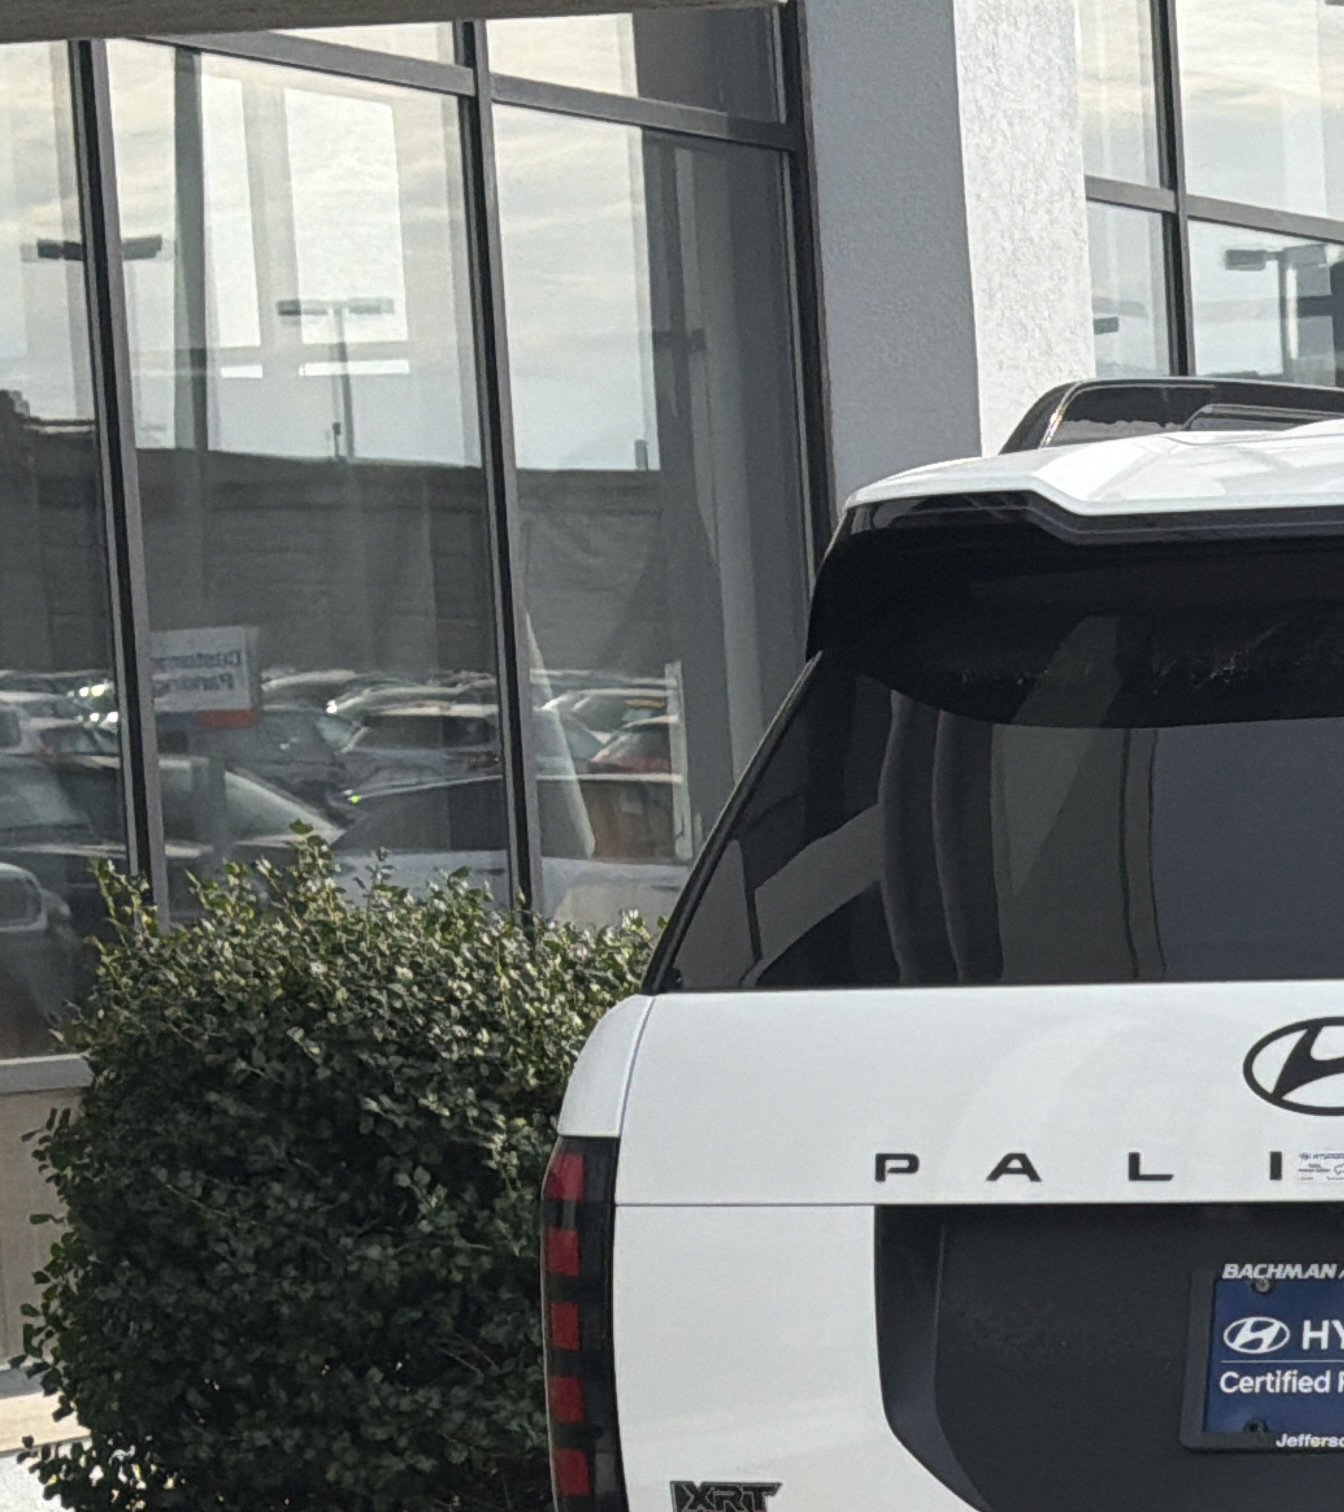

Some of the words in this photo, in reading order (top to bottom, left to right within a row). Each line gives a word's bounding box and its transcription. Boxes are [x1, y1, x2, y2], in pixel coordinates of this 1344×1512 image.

[1222, 1263, 1336, 1279] BACHMAN
[1220, 1370, 1330, 1393] Certified
[680, 1482, 775, 1512] XRT
